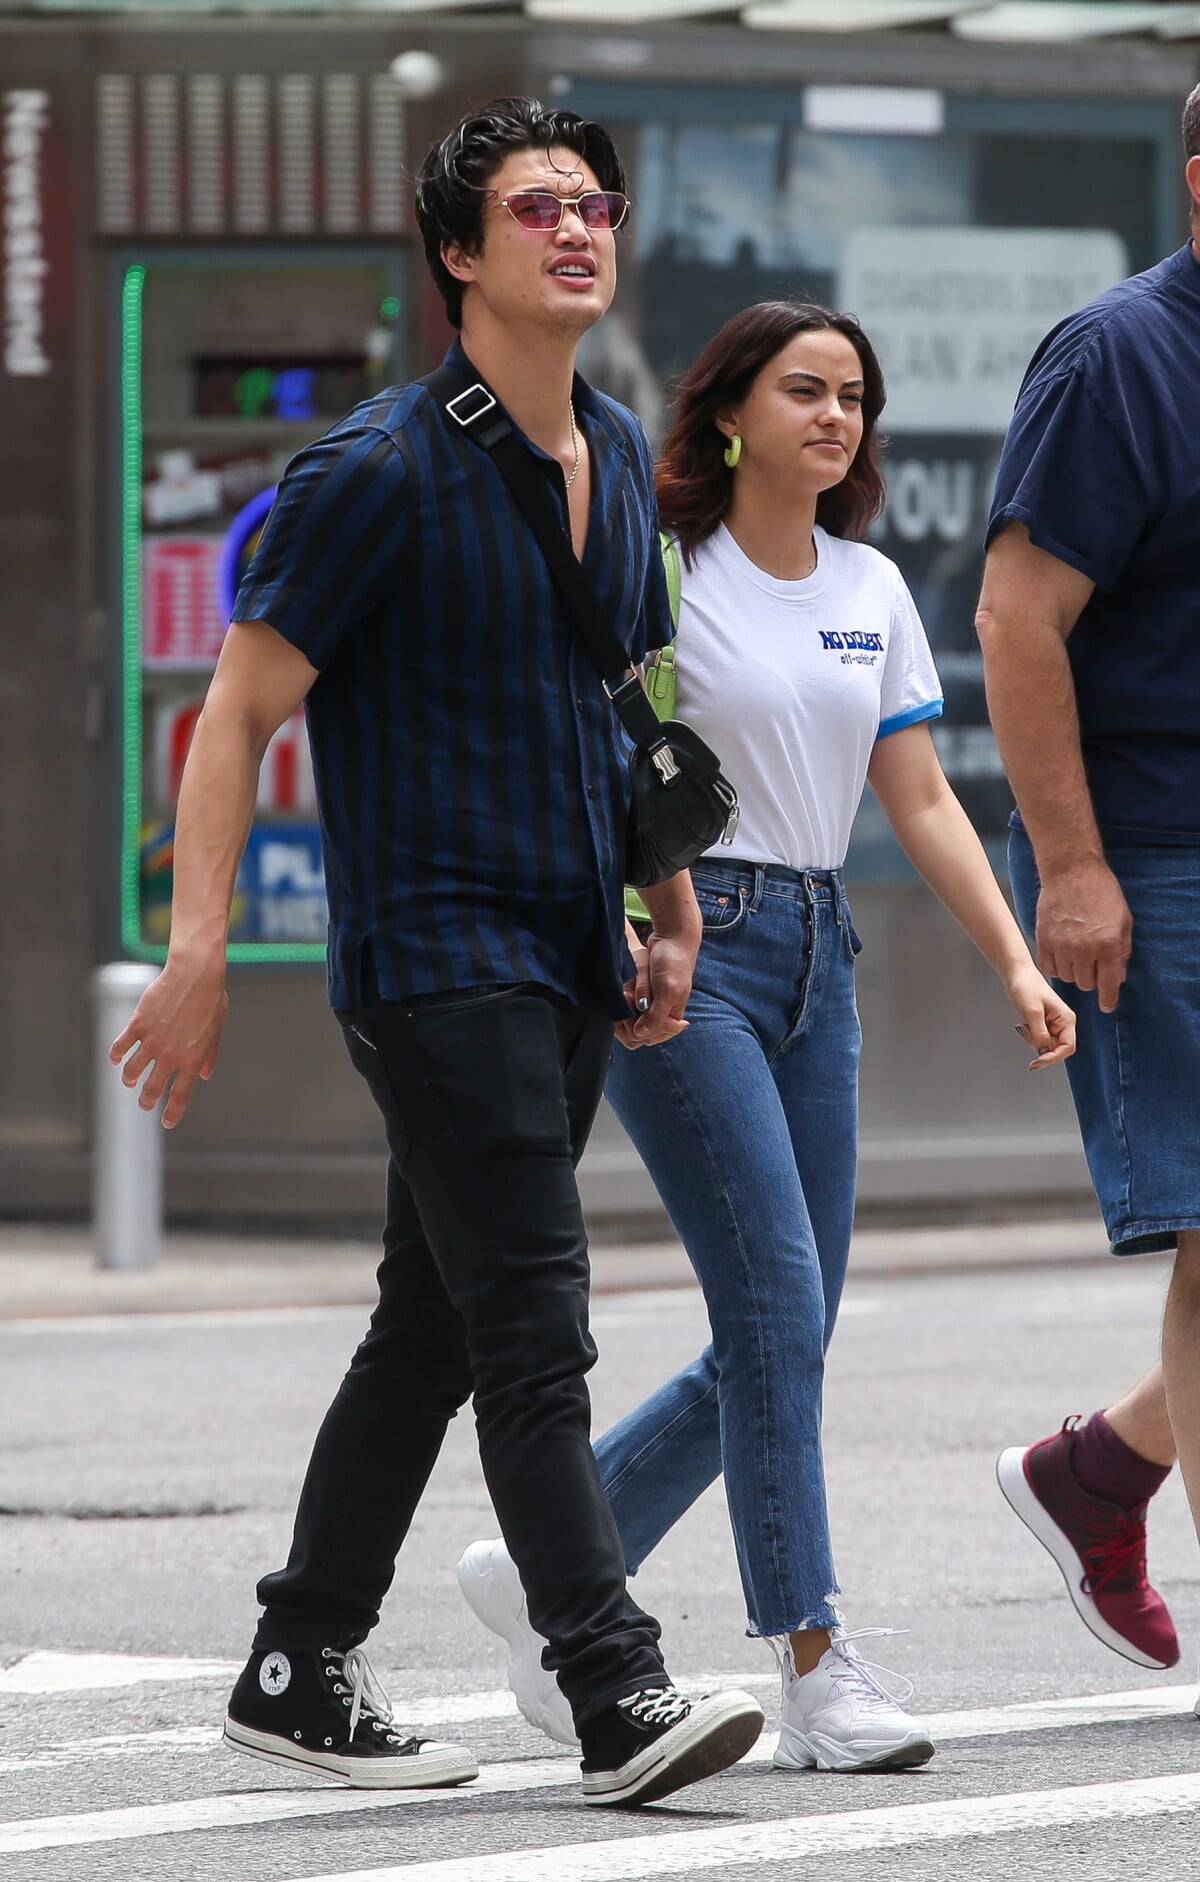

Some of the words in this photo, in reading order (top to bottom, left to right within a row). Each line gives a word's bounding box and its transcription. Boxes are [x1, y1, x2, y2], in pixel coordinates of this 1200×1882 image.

[4, 89, 50, 376] Newsstand
[818, 631, 844, 650] NO
[841, 631, 884, 652] DOUBT
